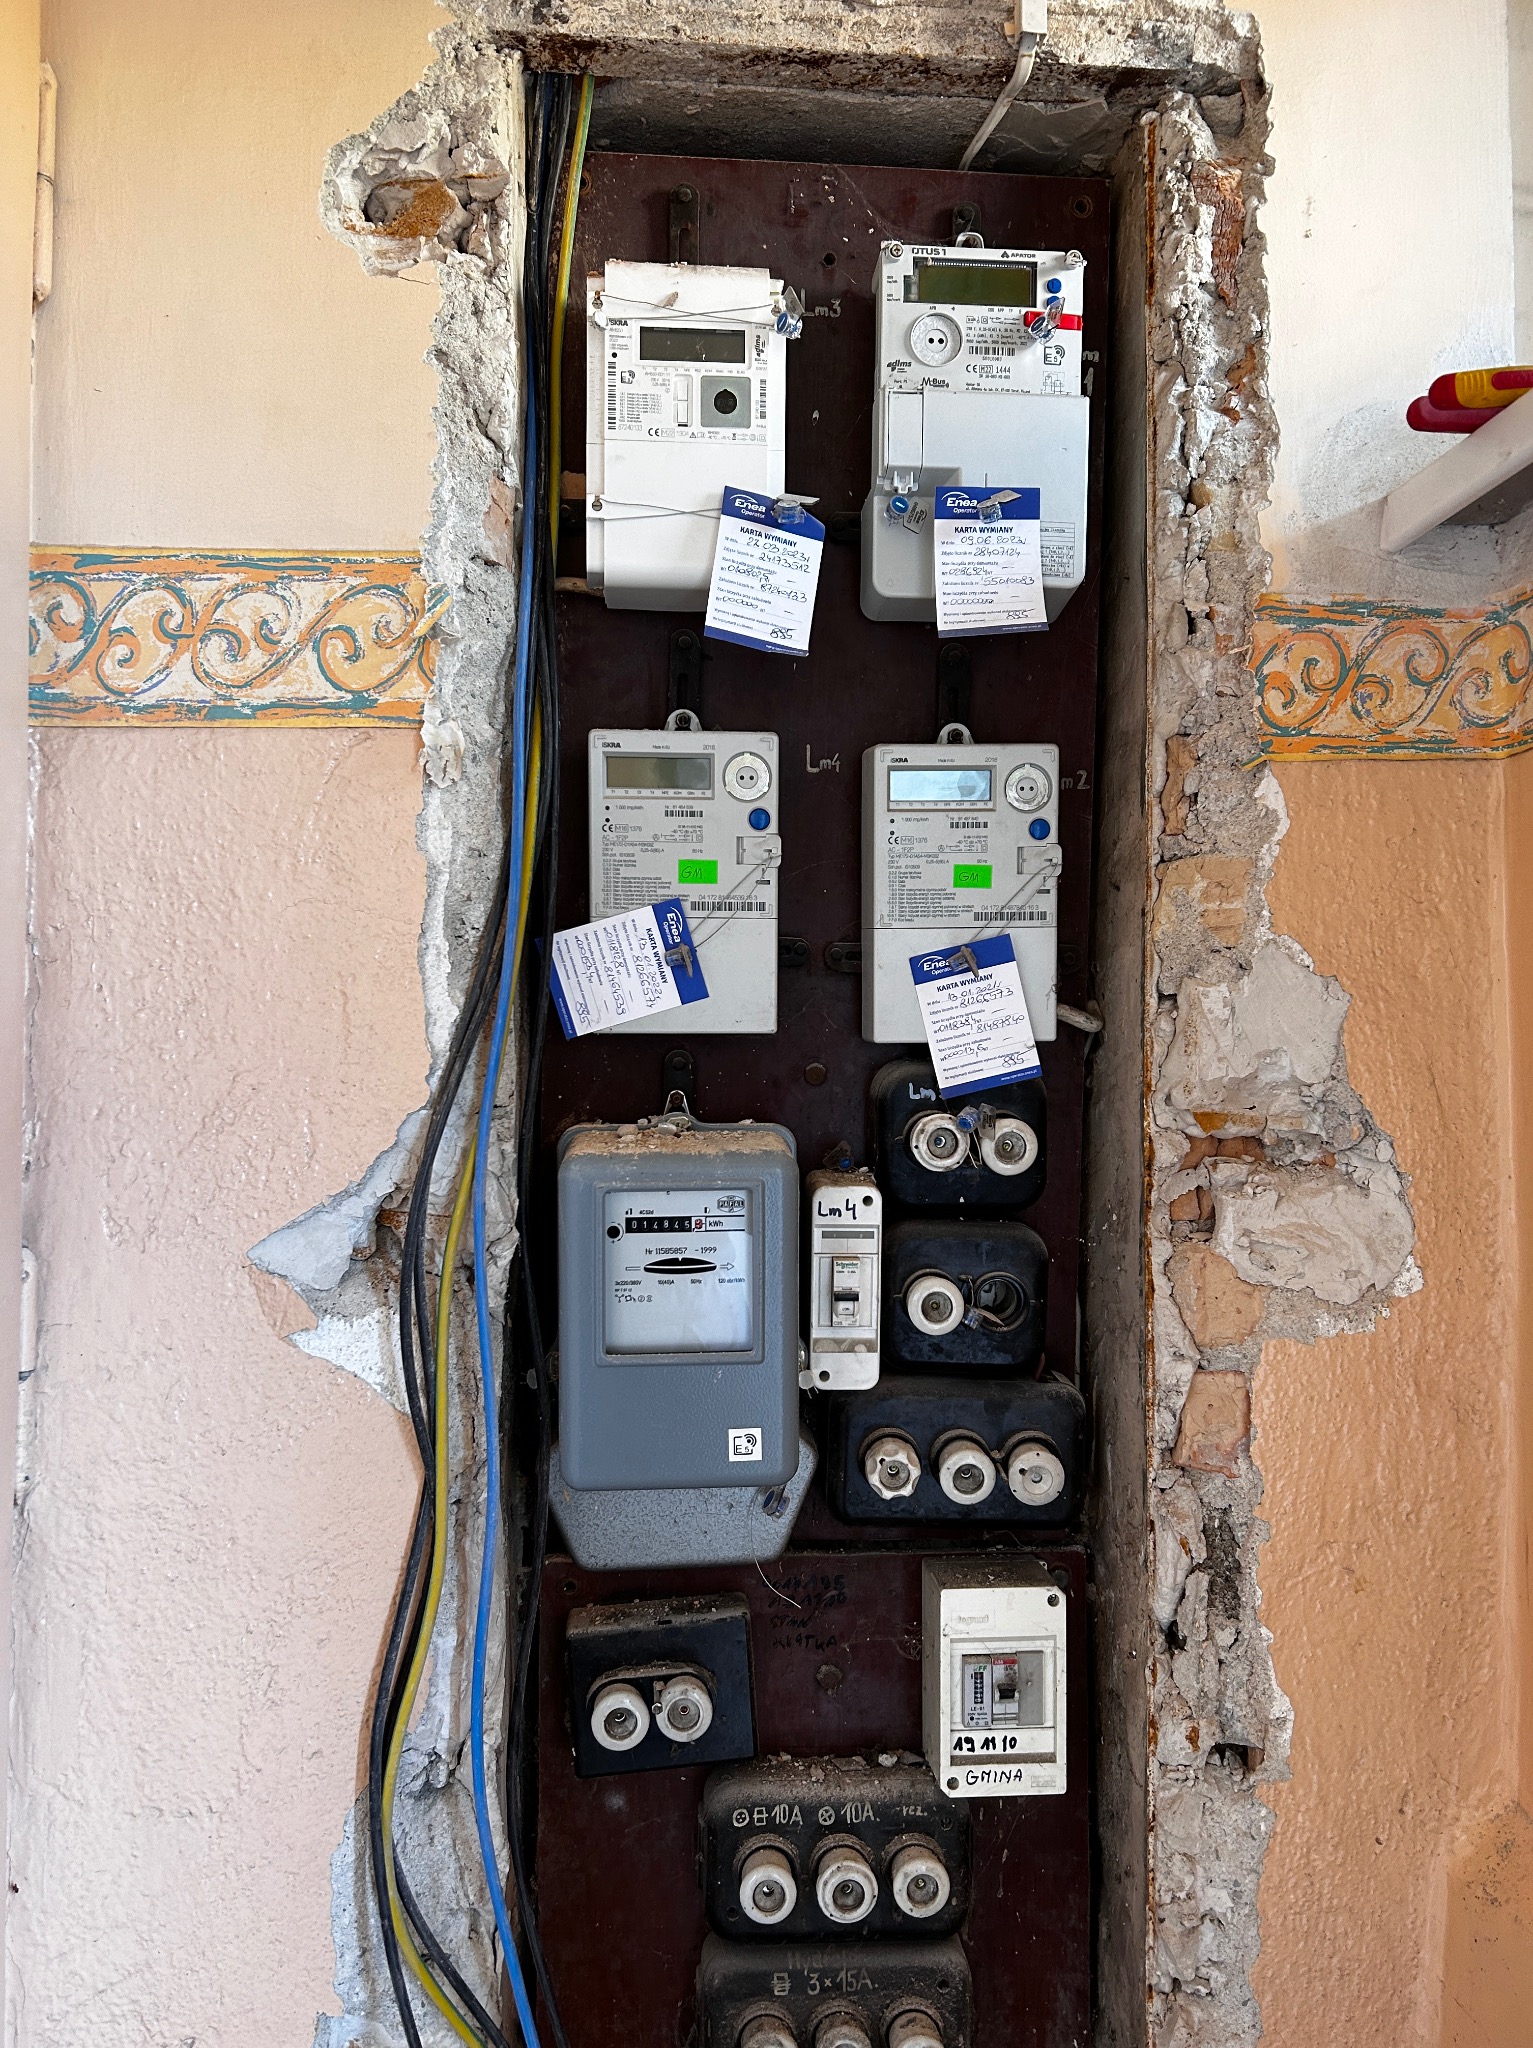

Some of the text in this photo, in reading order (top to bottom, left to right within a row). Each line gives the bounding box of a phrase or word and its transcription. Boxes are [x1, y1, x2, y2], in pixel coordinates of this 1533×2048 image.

[801, 288, 841, 318] Lm3
[996, 366, 1010, 374] 1444
[734, 498, 766, 512] Enea
[946, 497, 977, 506] Enea
[739, 526, 797, 546] KARTA WYMIANY
[806, 744, 841, 773] Lm4
[662, 921, 673, 945] Operator
[667, 912, 681, 943] Enea
[646, 927, 667, 984] KARTA WYMIANY
[936, 971, 993, 992] KARTA WYMIANY
[975, 1012, 1025, 1033] 81487840
[909, 1082, 942, 1101] Lm
[953, 1737, 975, 1752] 19
[1002, 1735, 1017, 1752] 10
[966, 1769, 1023, 1786] GMINA
[771, 1803, 803, 1826] 10A
[841, 1801, 880, 1824] 10A.
